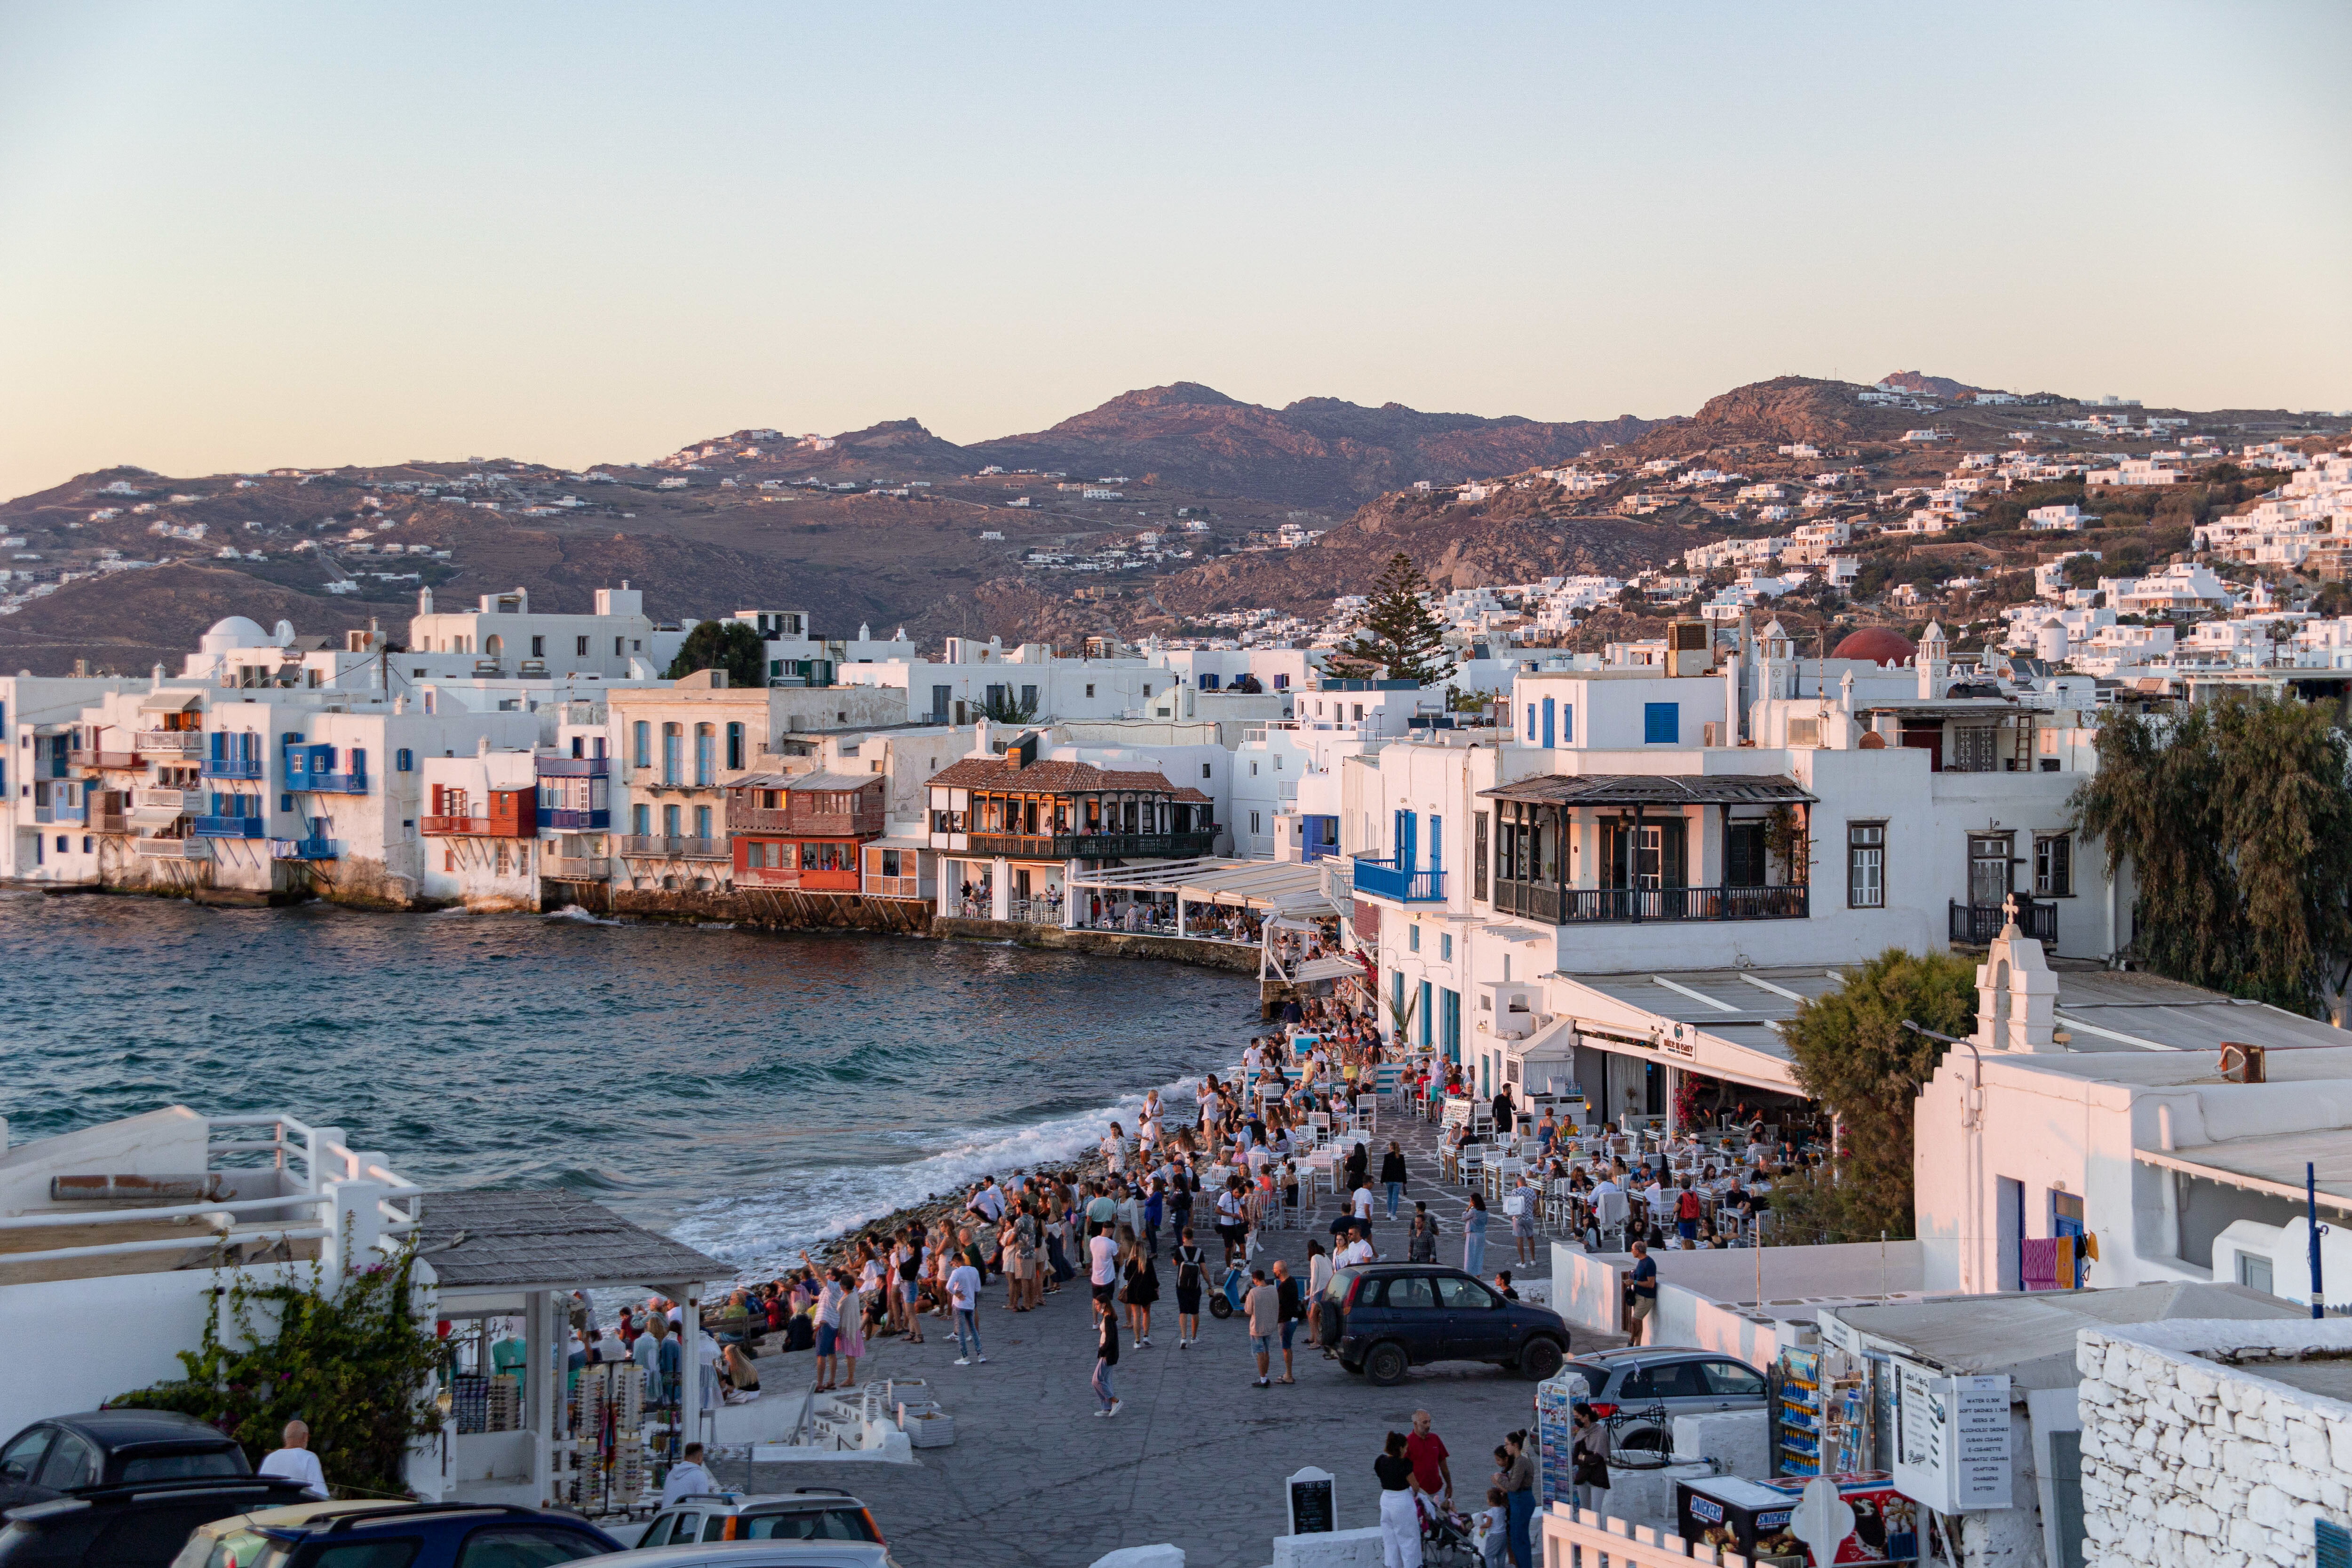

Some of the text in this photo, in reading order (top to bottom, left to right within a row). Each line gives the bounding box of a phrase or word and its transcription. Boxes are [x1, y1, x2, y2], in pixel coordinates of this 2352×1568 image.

[1664, 1038, 1675, 1048] nice
[1680, 1043, 1693, 1052] easy
[1906, 1384, 1924, 1397] COHIBA
[1691, 1496, 1722, 1521] SNICKERS
[1757, 1511, 1791, 1524] SNICKER
